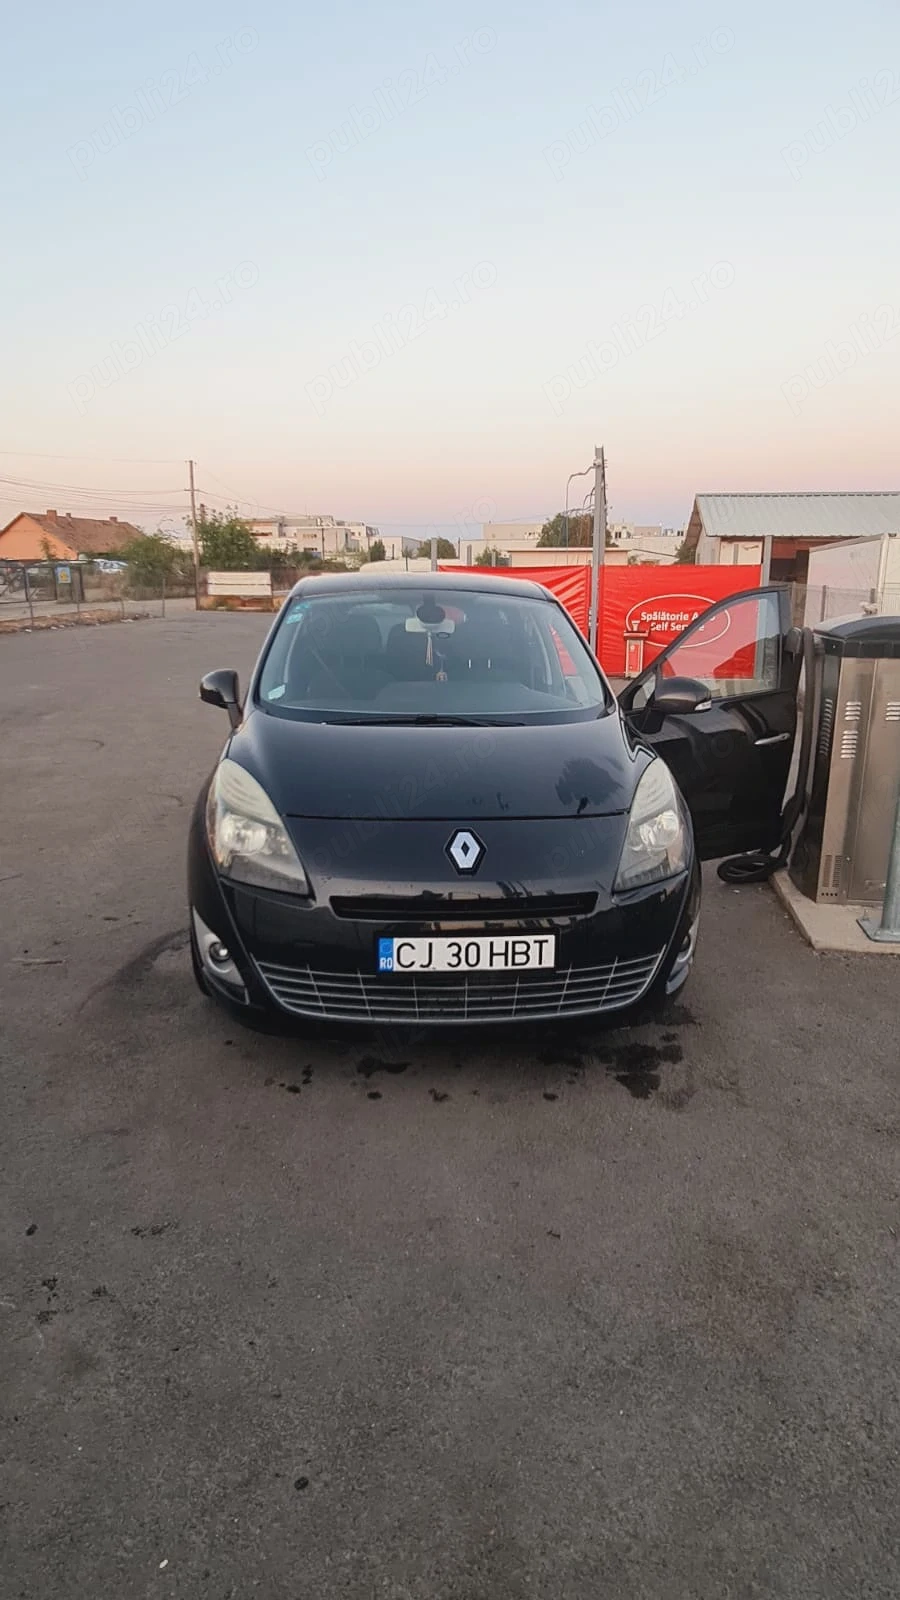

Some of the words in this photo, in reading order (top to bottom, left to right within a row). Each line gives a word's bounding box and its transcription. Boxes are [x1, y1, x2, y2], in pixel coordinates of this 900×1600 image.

[651, 621, 669, 631] Self
[670, 621, 705, 631] Sere
[396, 942, 433, 968] CJ
[446, 941, 481, 968] 30
[489, 939, 549, 967] HBT
[380, 957, 393, 969] RO
